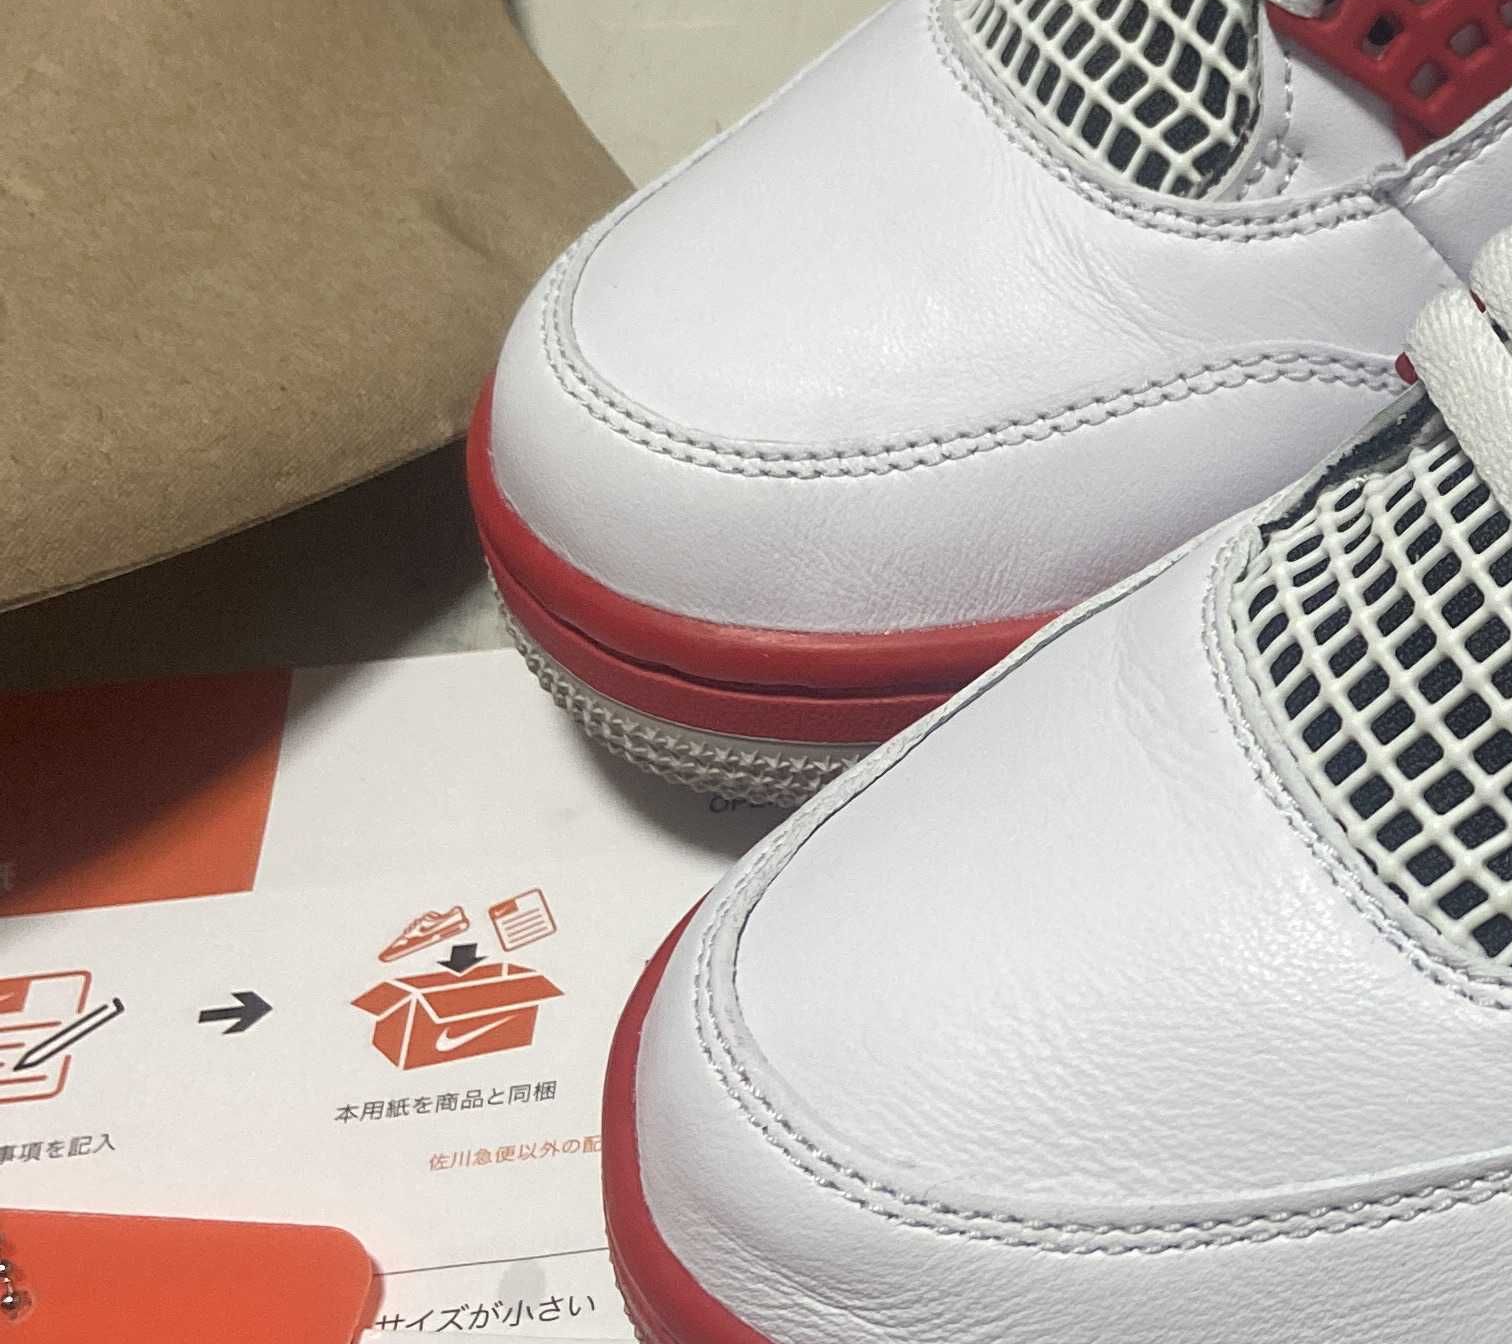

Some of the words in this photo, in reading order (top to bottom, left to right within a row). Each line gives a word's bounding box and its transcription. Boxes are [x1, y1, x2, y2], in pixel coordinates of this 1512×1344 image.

[334, 1080, 558, 1125] 本用紙を商品と同梱
